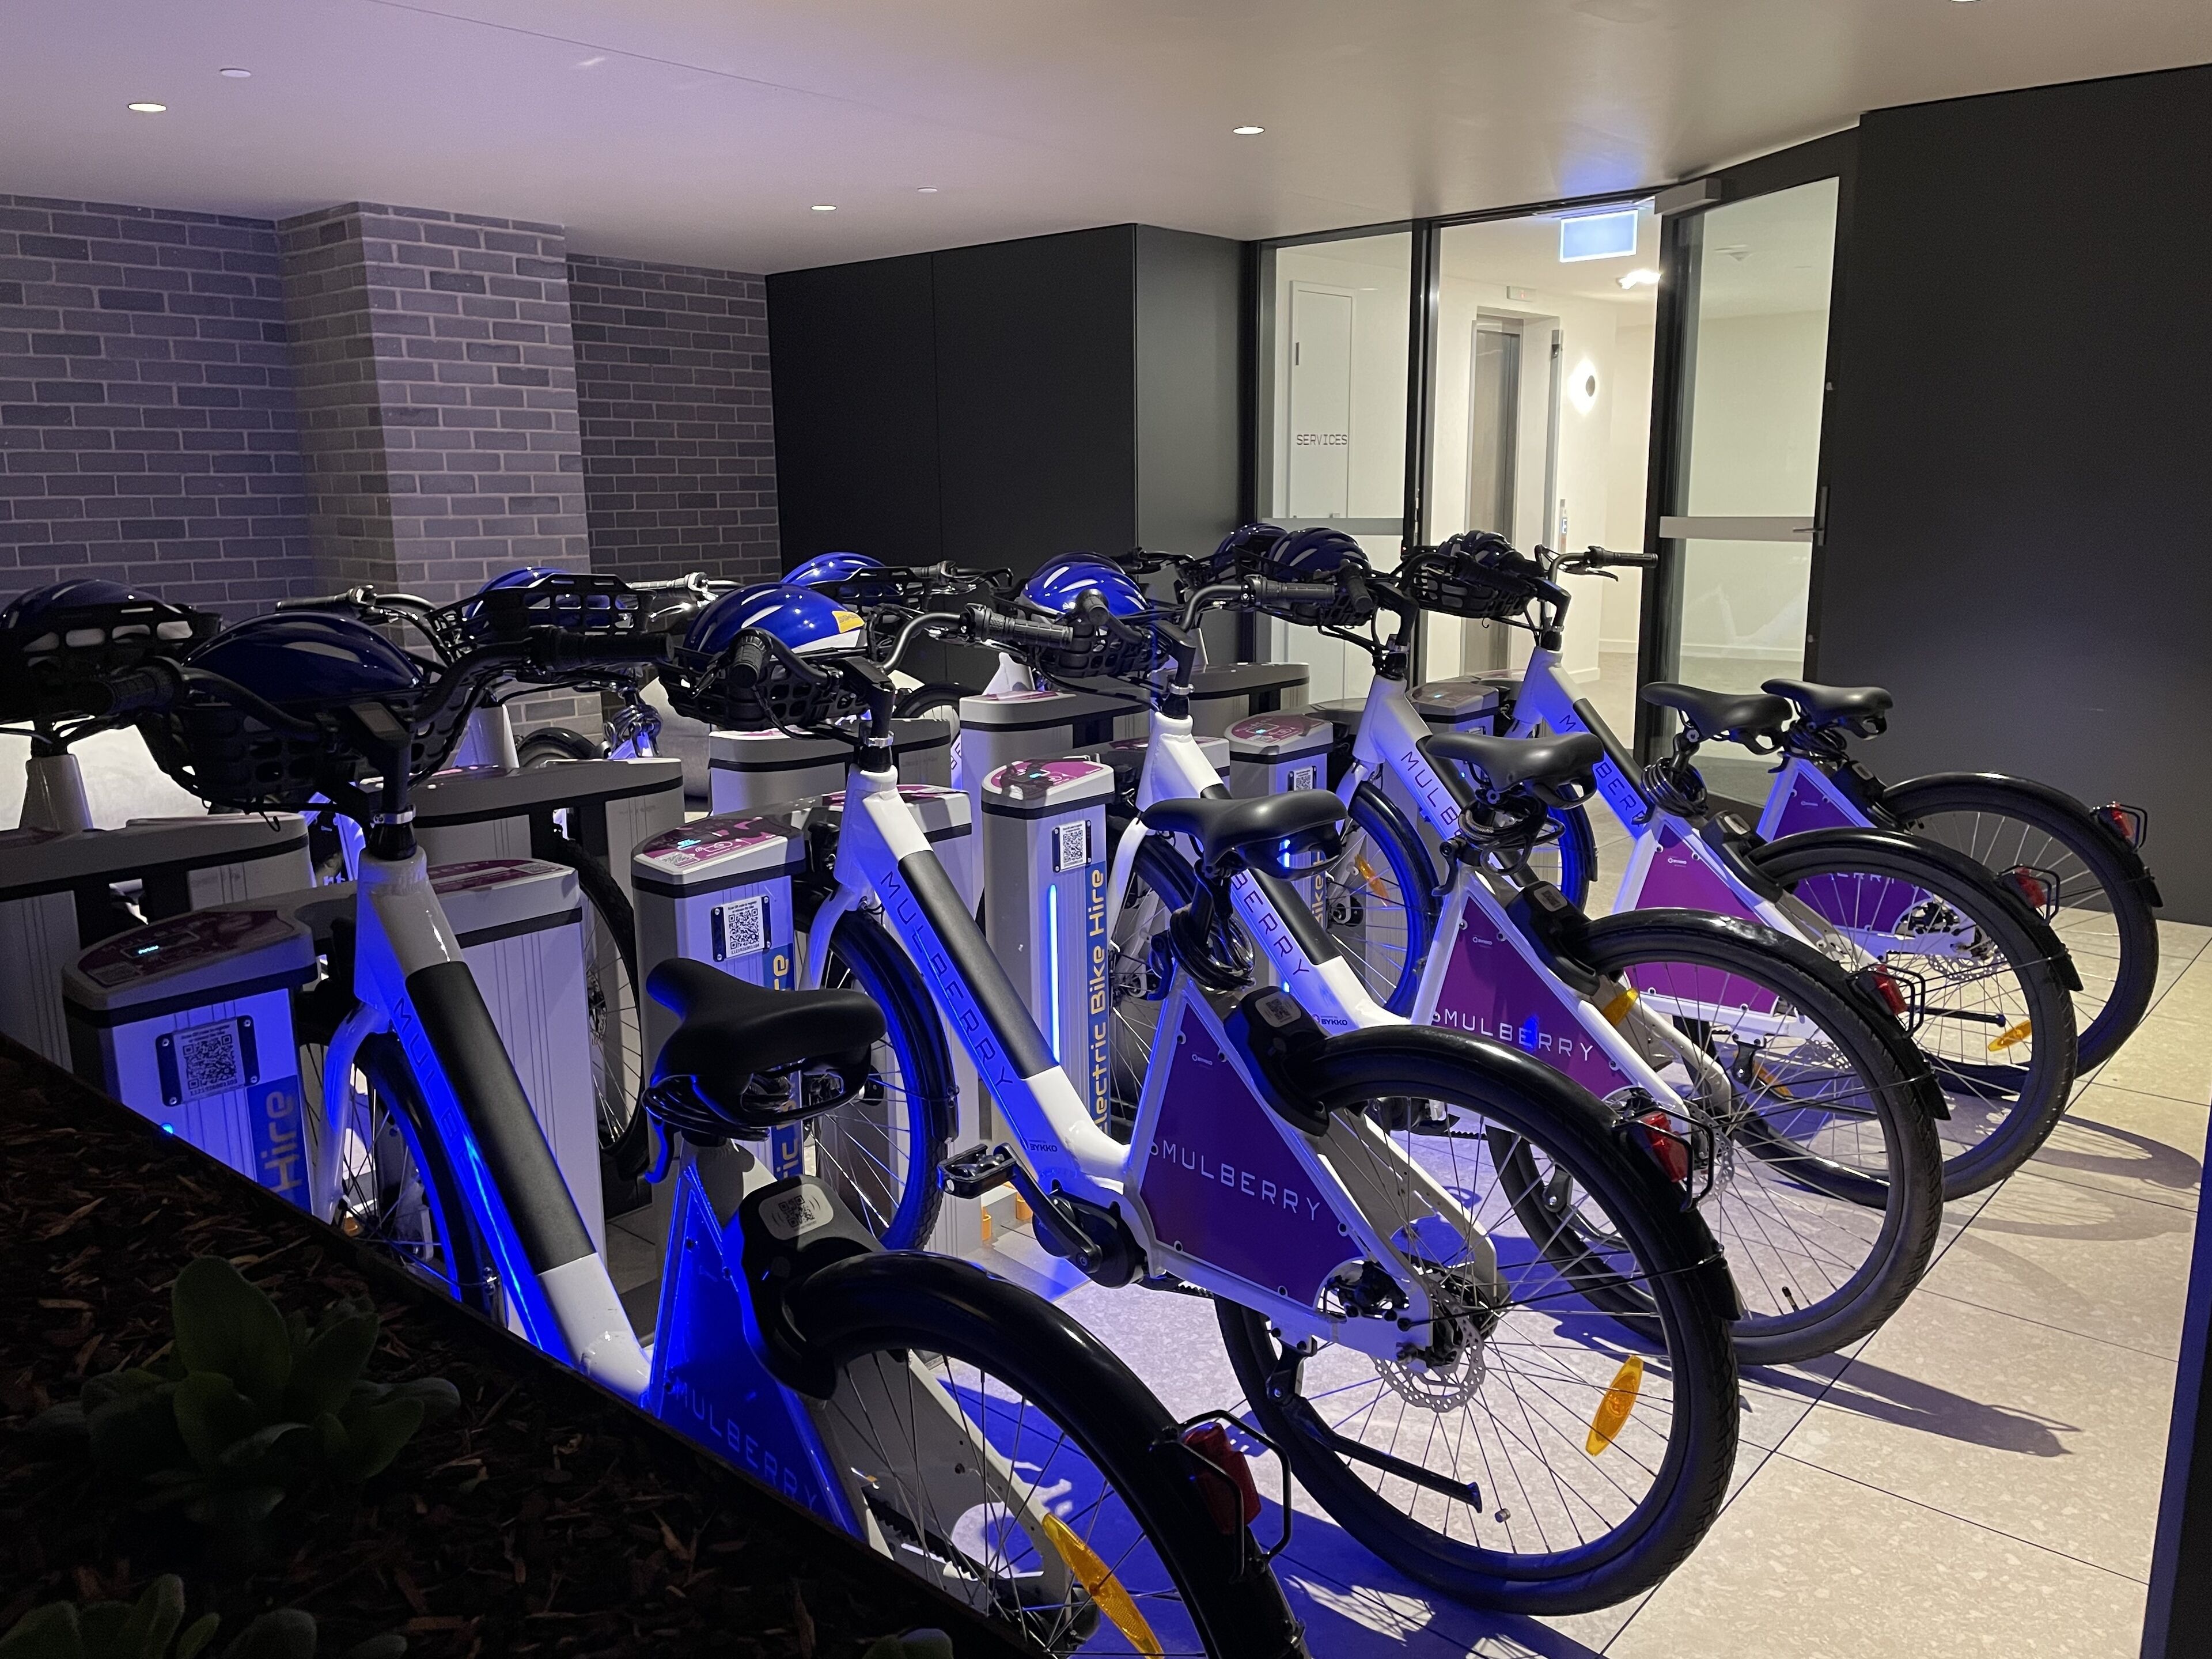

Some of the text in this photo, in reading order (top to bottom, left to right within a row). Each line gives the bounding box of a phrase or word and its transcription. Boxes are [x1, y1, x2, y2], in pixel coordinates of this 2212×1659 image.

[1296, 434, 1348, 445] SERVICES
[1400, 751, 1463, 837] MULB
[1088, 869, 1105, 937] Hire
[1232, 872, 1310, 975] BERRY
[880, 870, 1013, 1087] MULBERRY
[1089, 945, 1105, 1015] Bike
[1444, 1008, 1593, 1061] MULBERRY
[260, 1091, 303, 1193] Hire
[1029, 1143, 1058, 1152] BYKKO
[1162, 1139, 1320, 1221] MULBERRY
[676, 1382, 818, 1512] MULBERRY
